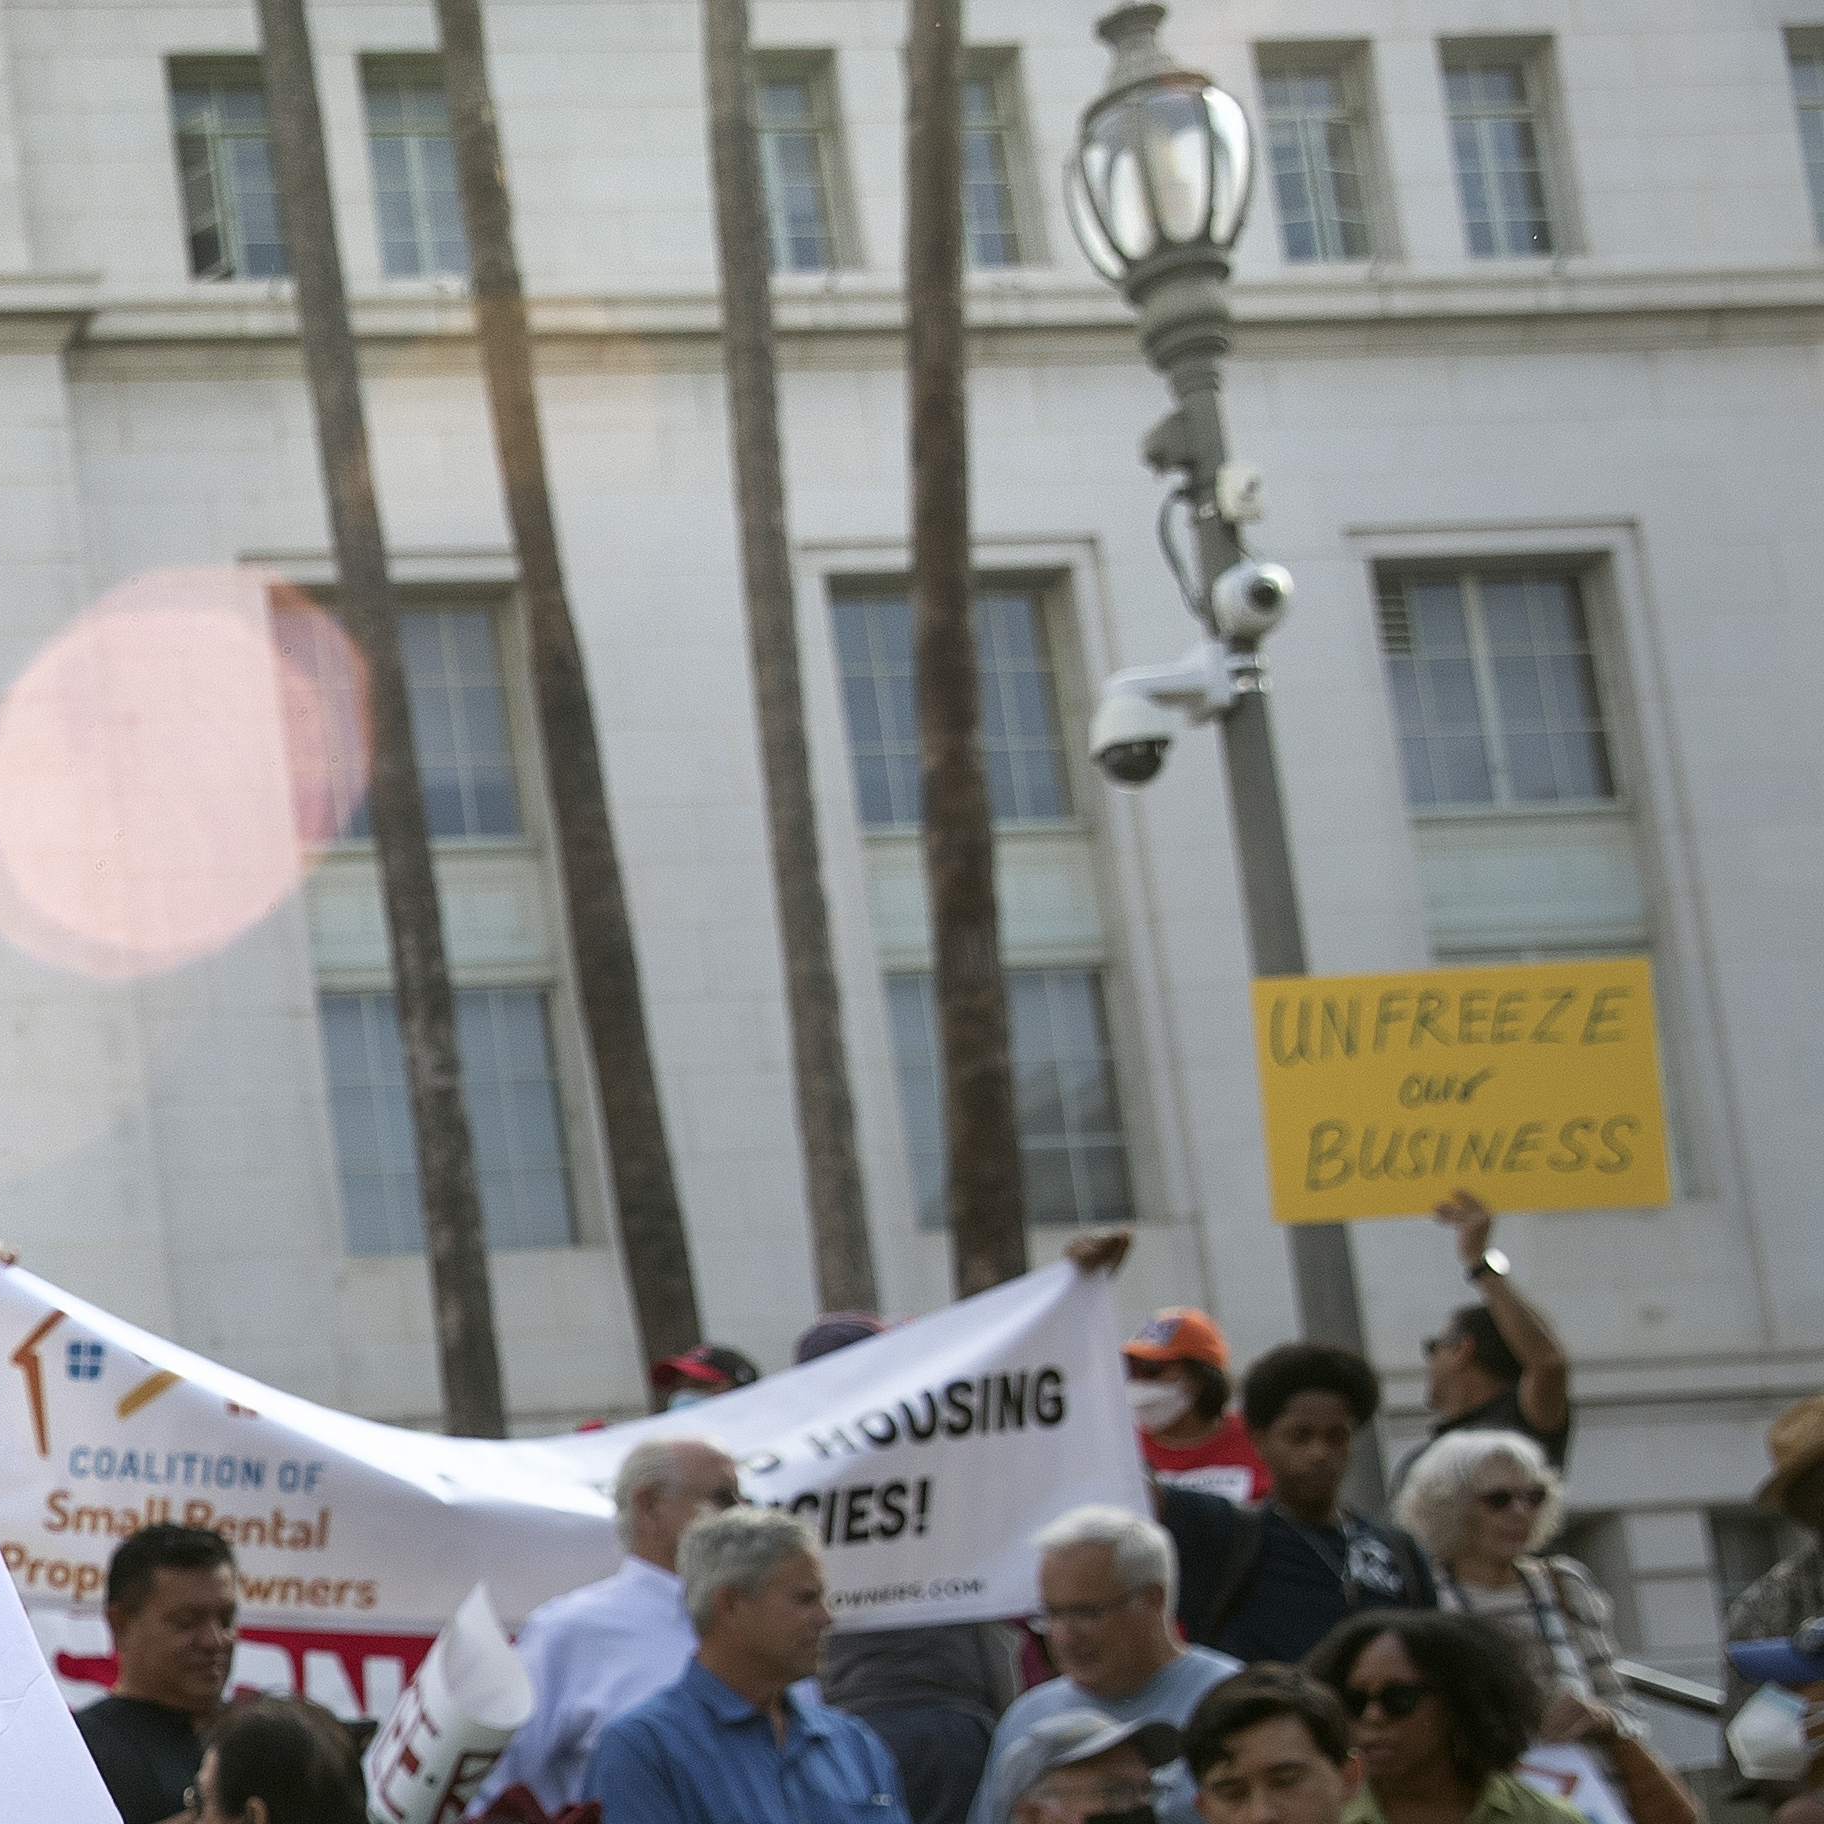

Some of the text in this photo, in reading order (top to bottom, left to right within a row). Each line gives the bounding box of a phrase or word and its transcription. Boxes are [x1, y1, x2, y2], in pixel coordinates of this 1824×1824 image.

[1269, 984, 1633, 1068] UNFREEZE
[1304, 1114, 1642, 1192] BUSINESS
[808, 1367, 1065, 1457] HOUSING
[67, 1444, 325, 1494] COALITION OF
[237, 1573, 378, 1610] wners
